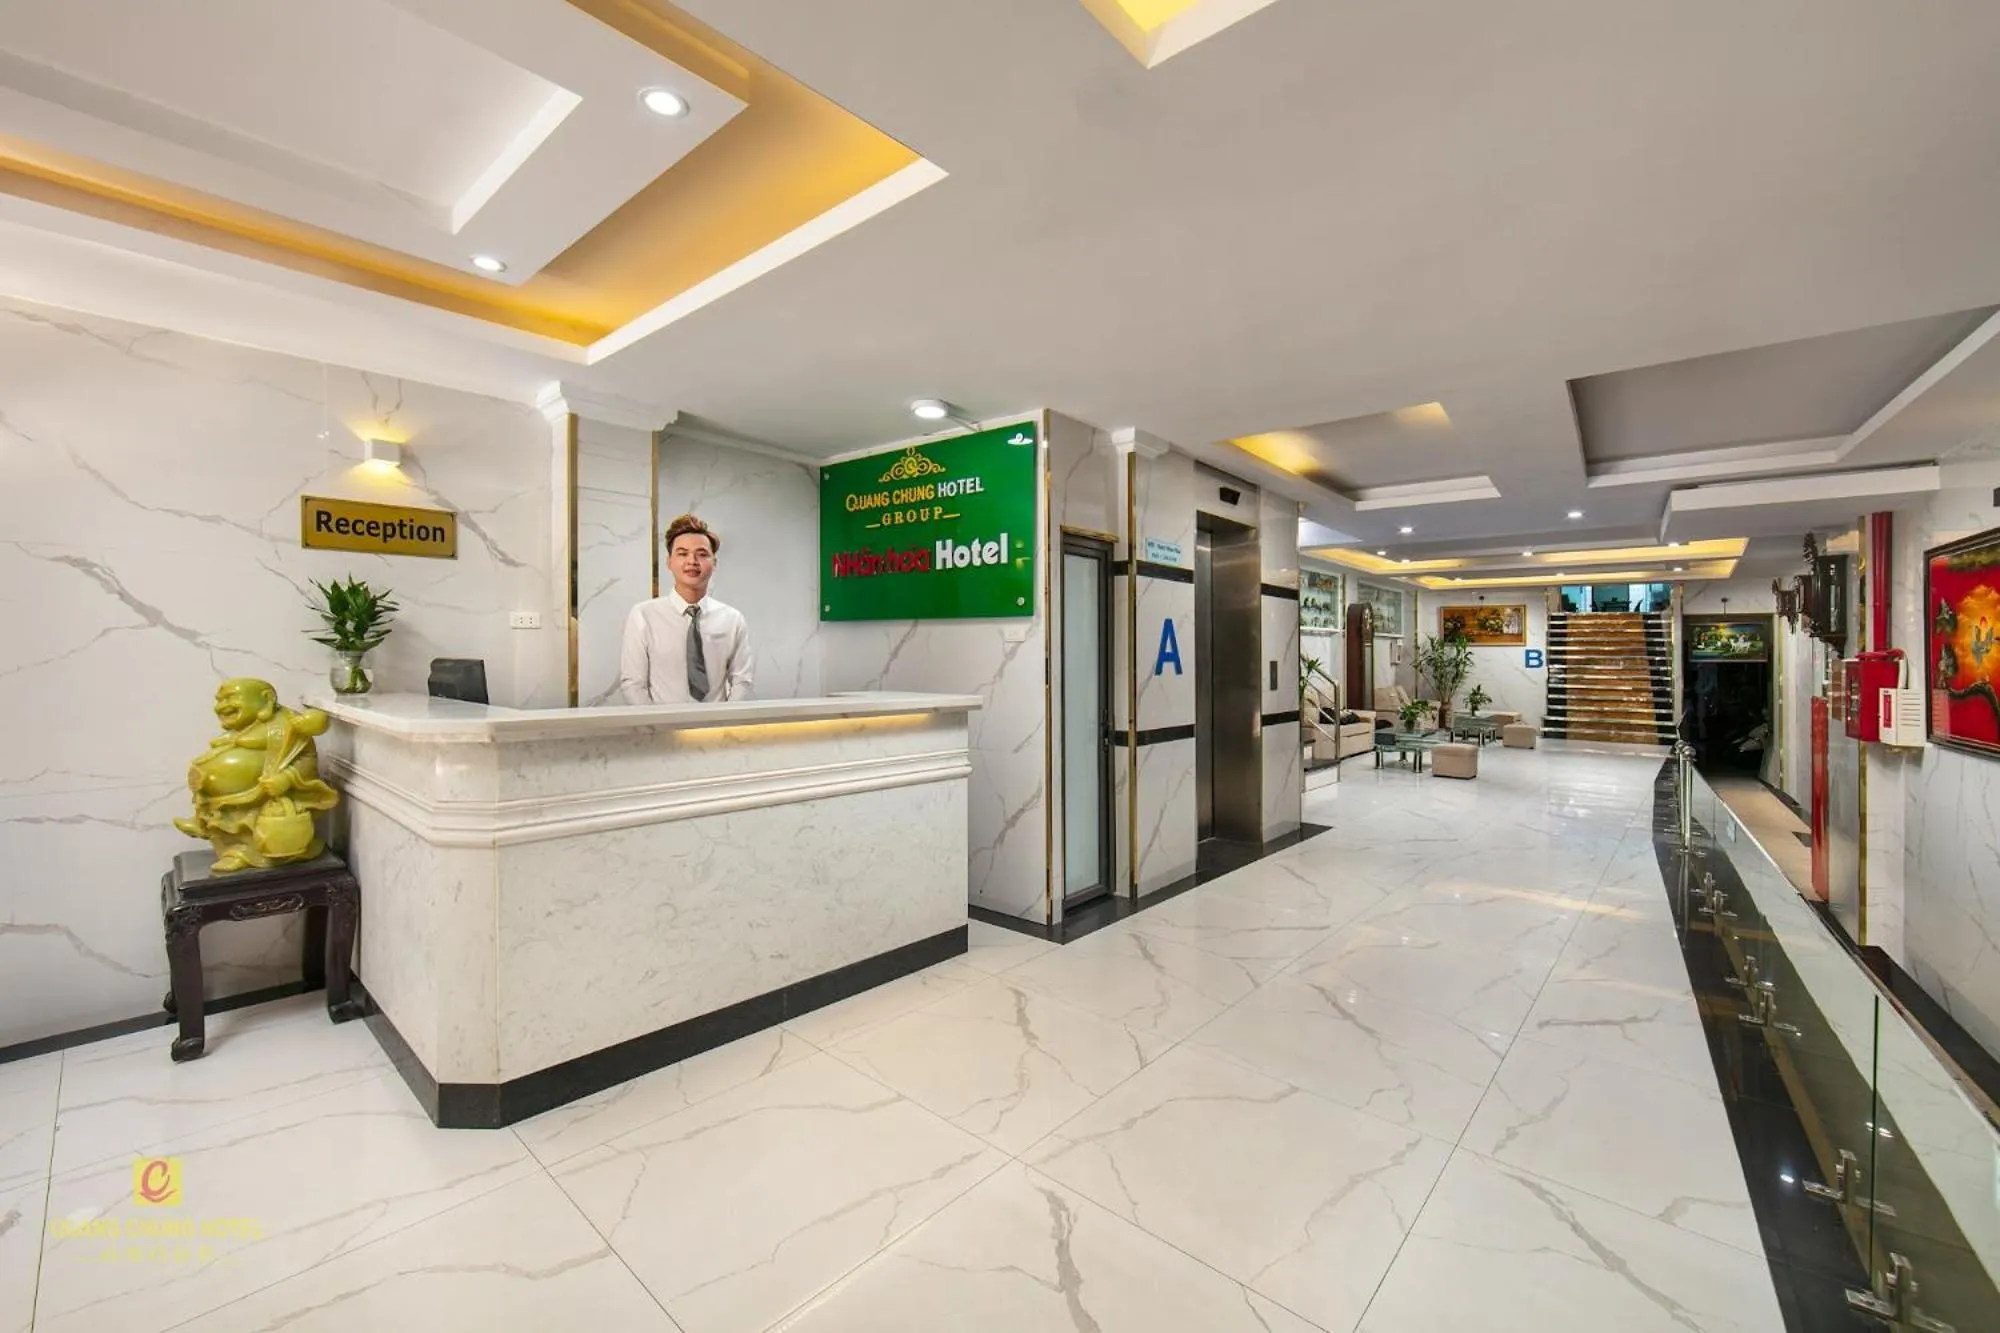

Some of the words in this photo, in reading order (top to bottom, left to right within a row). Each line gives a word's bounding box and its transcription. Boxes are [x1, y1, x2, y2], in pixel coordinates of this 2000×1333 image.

[846, 491, 890, 512] QUANG
[892, 484, 935, 505] CHUNG
[937, 476, 984, 498] HOTEL
[316, 510, 445, 543] Reception
[882, 506, 943, 526] GROUP
[935, 532, 1009, 570] Hotel
[1155, 618, 1183, 676] A
[1525, 649, 1544, 668] B
